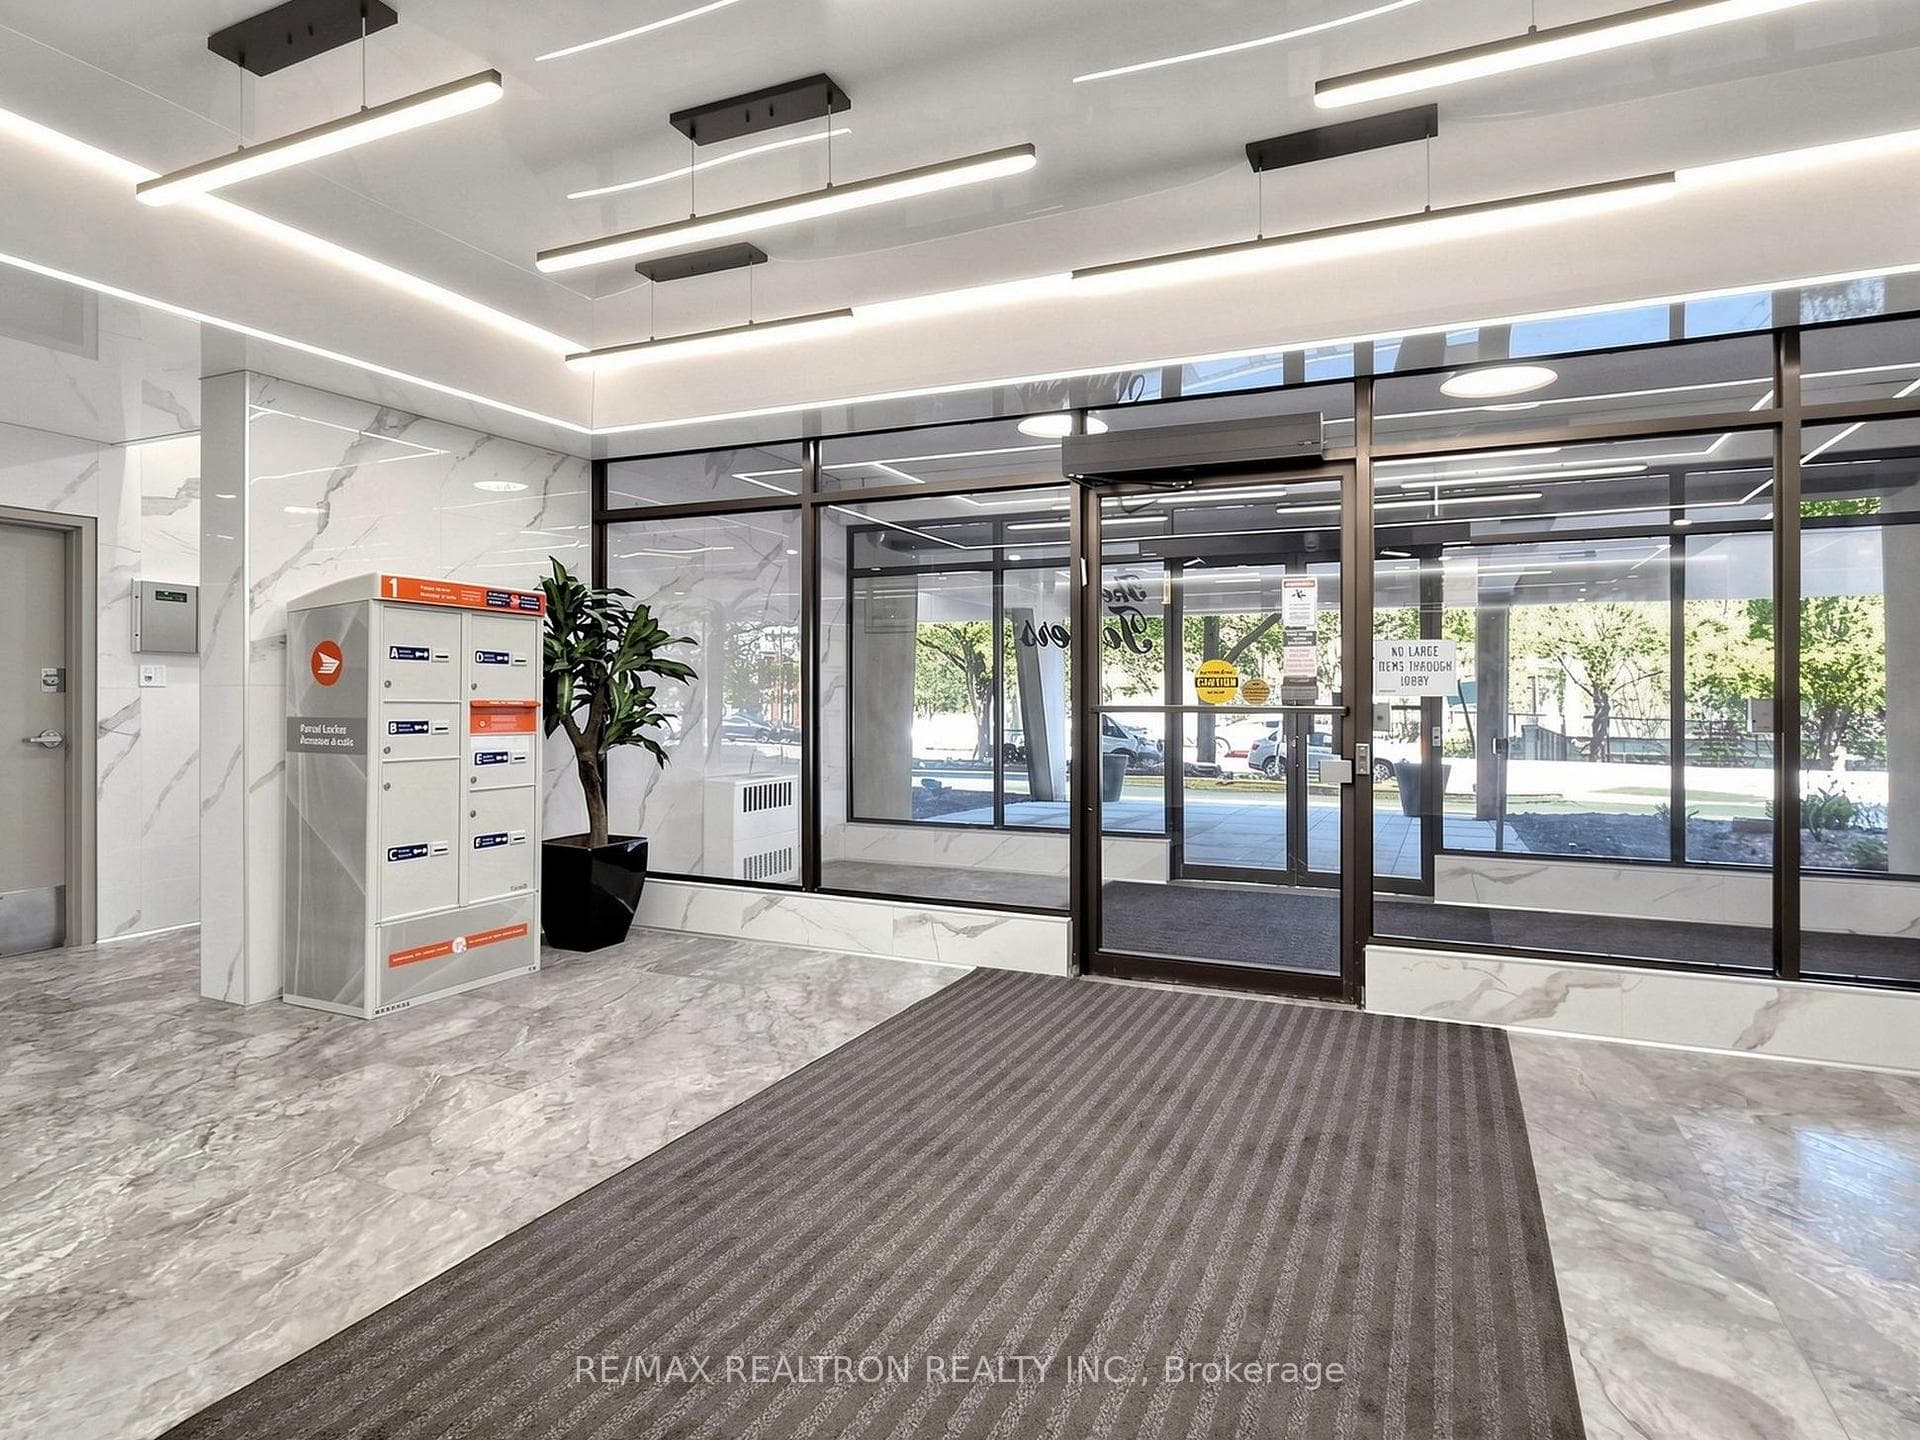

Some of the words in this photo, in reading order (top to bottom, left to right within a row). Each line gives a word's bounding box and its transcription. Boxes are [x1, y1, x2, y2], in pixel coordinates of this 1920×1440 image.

[389, 578, 398, 598] 1
[391, 647, 399, 659] A
[1391, 646, 1404, 657] NO
[1408, 645, 1439, 657] LARGE
[1409, 660, 1453, 672] THROUGH
[1400, 675, 1429, 687] LOBBY
[390, 722, 397, 734] B
[476, 753, 482, 765] E
[389, 849, 398, 861] C
